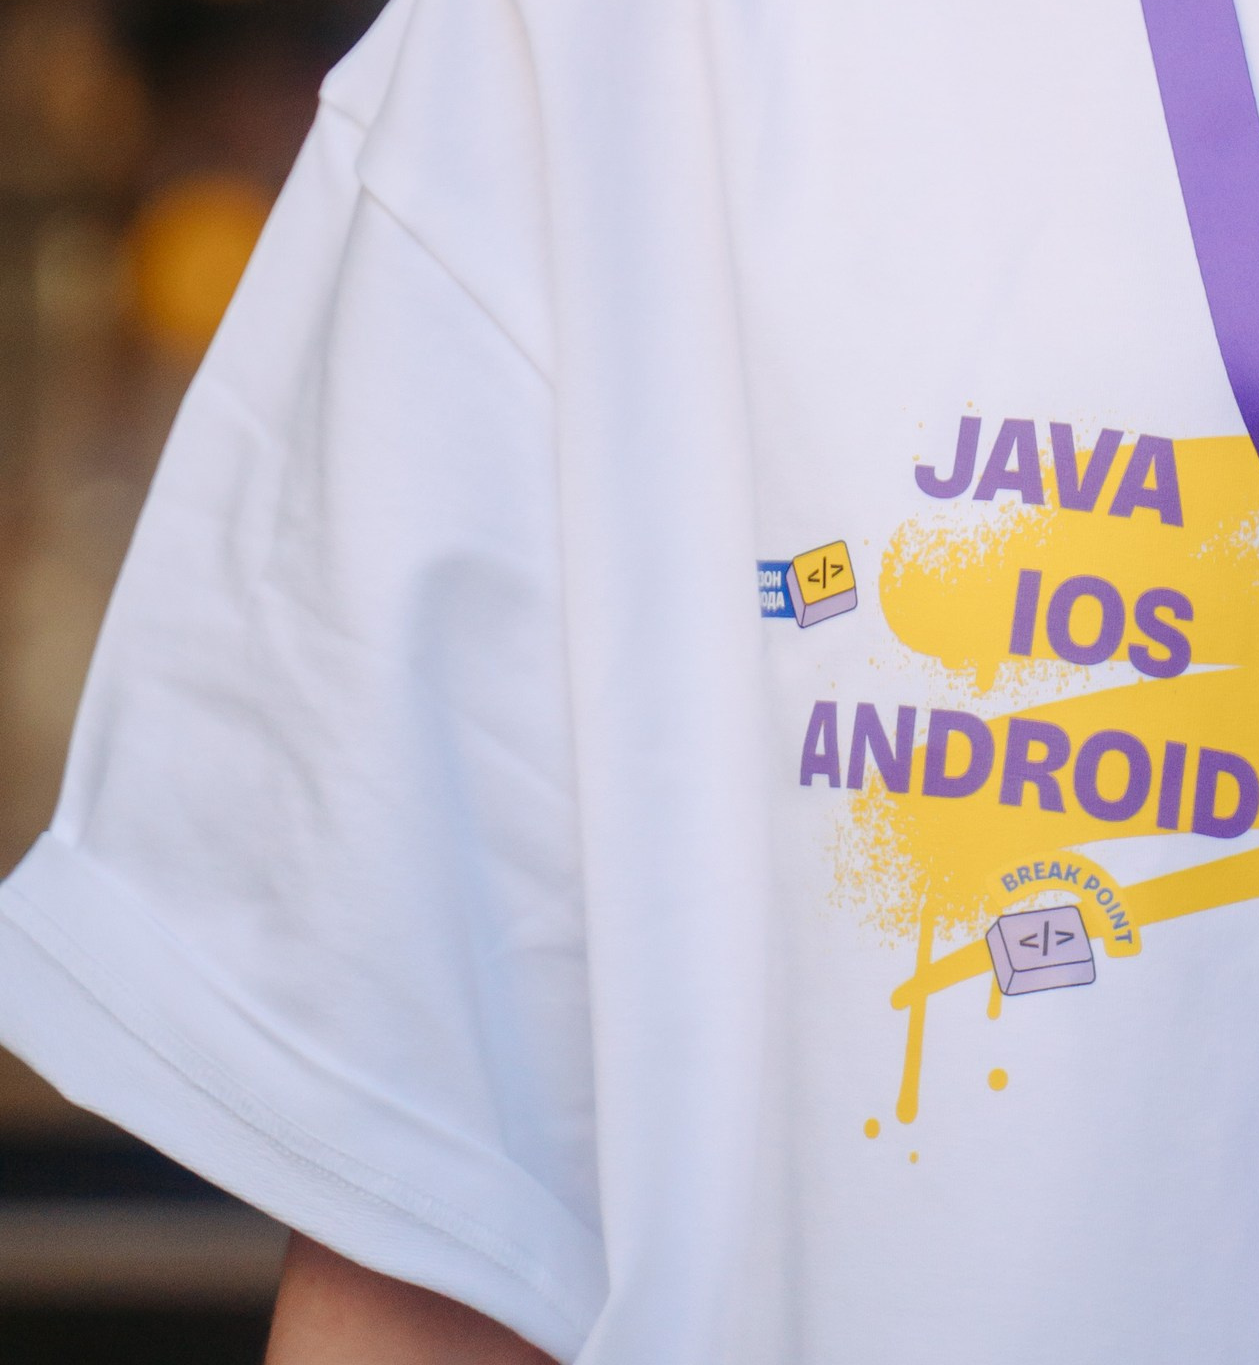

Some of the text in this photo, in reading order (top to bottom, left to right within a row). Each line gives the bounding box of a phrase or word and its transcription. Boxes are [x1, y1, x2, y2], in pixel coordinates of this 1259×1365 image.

[913, 415, 1184, 528] JAVA
[1008, 568, 1195, 679] IOS
[1000, 861, 1133, 944] BREAK POINT
